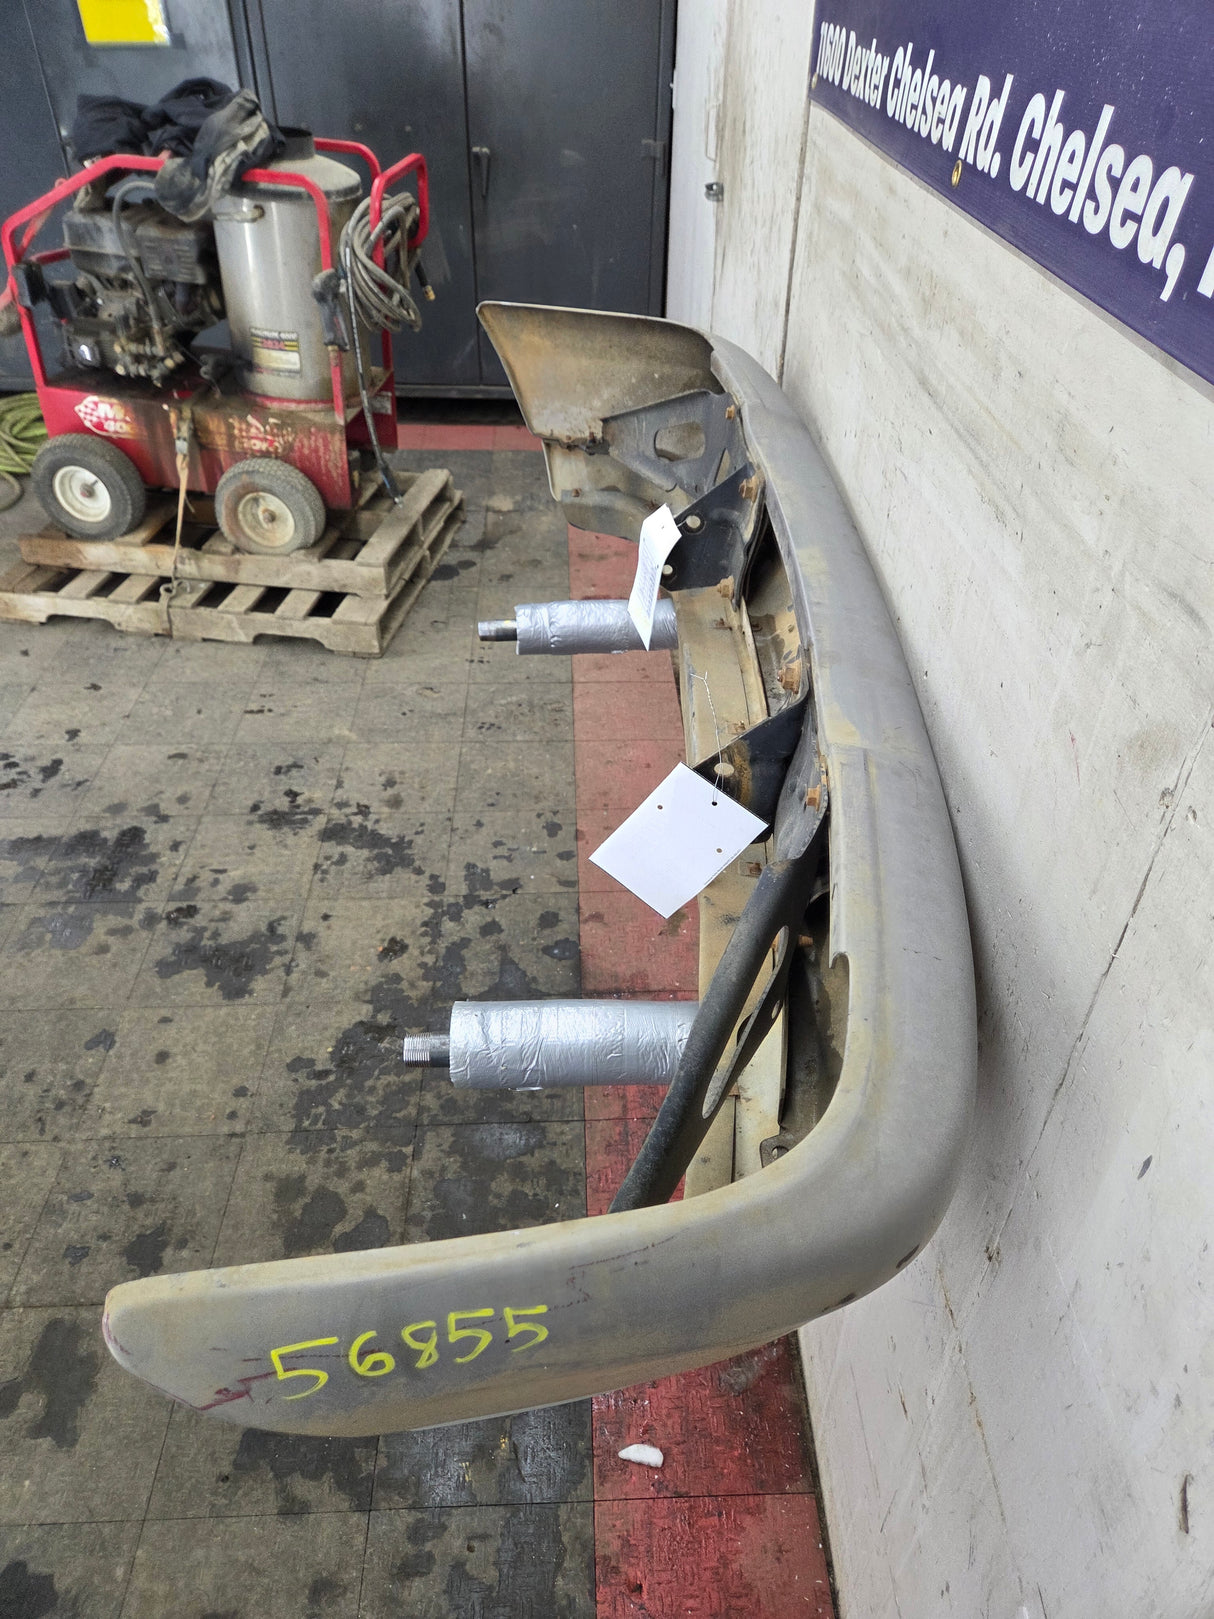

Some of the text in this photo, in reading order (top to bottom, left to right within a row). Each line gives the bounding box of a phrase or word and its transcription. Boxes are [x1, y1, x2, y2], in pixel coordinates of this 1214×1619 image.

[816, 21, 847, 87] 11600
[842, 30, 890, 110] Dexter
[887, 41, 968, 153] Chelsea
[959, 73, 1015, 179] Rd.
[1010, 88, 1195, 302] Chelsea,
[269, 1304, 549, 1401] 56855
